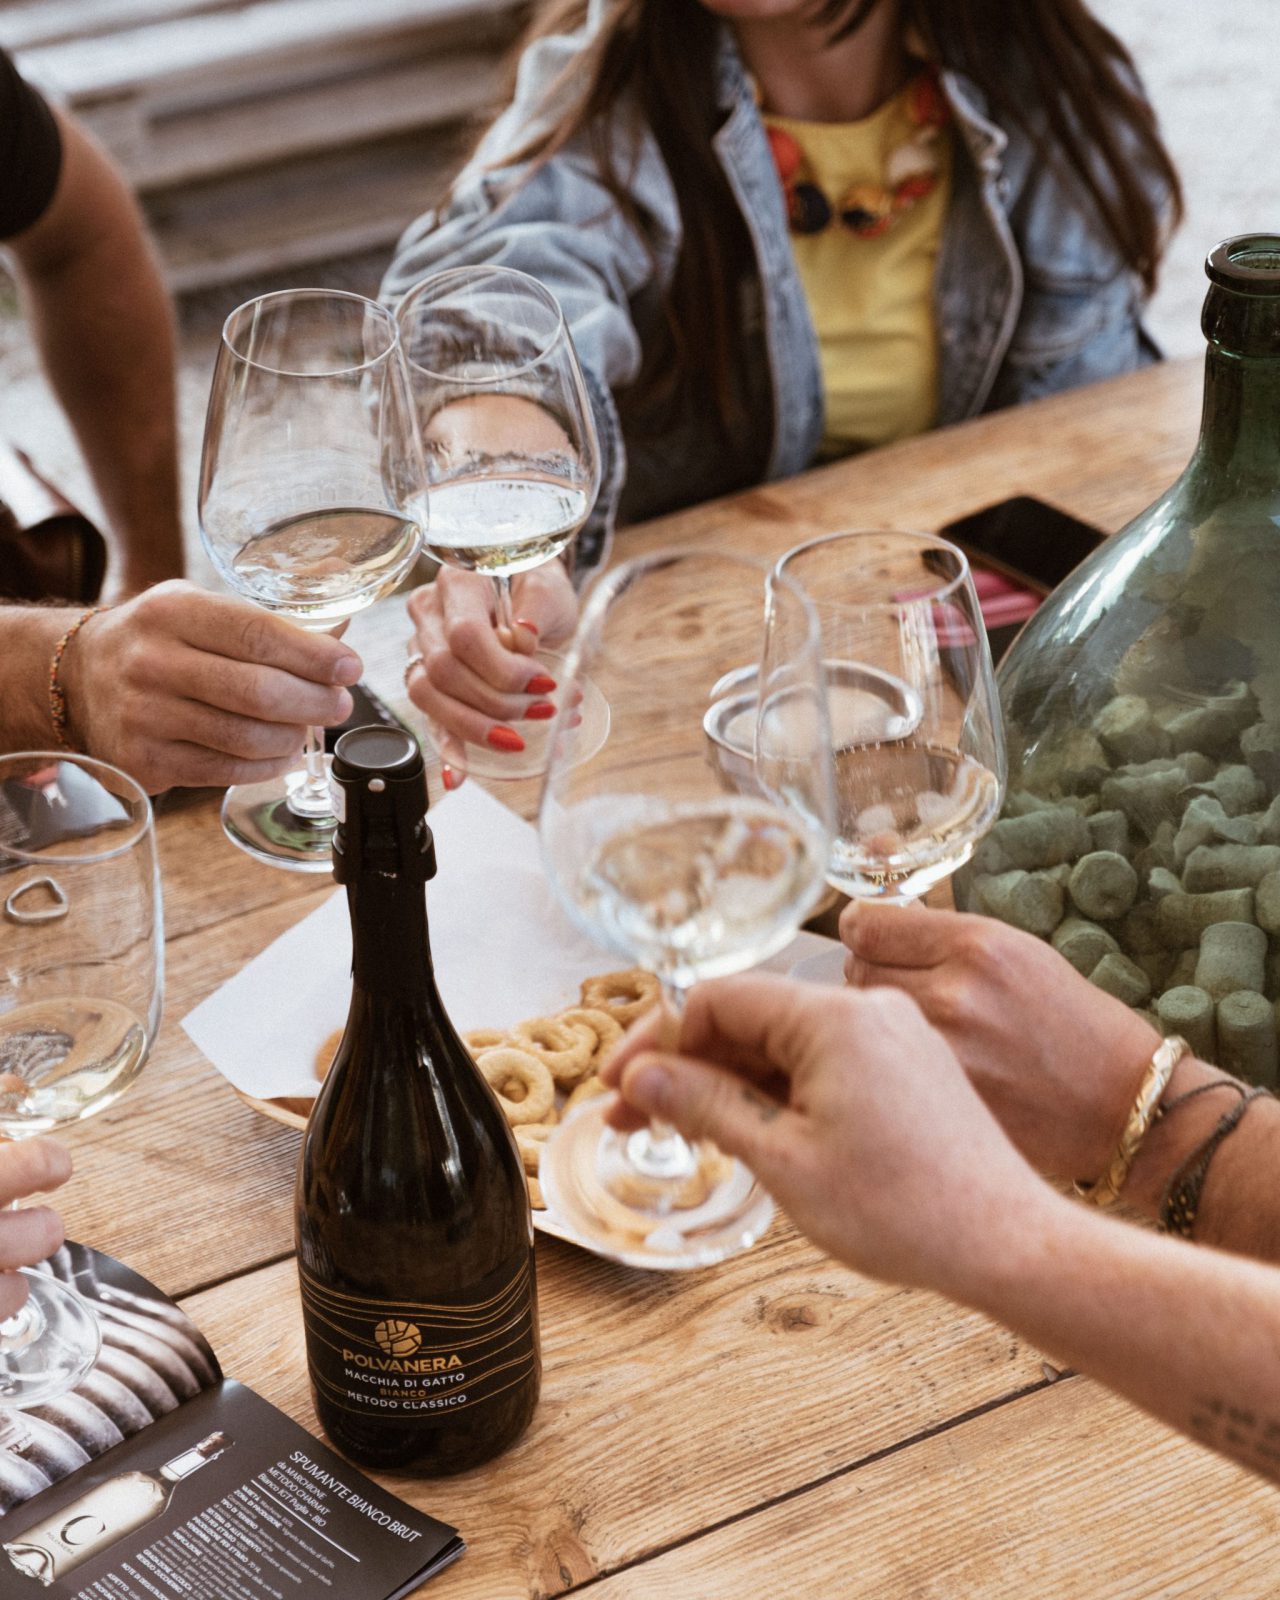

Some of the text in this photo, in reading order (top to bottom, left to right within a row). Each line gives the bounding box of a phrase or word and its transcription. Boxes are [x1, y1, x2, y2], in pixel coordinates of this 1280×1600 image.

[342, 1348, 463, 1373] POLVANERA
[345, 1368, 466, 1388] MACCHIA DI GATTO
[347, 1390, 468, 1410] METODO CLASSICO
[379, 1388, 426, 1398] BIANCO
[258, 1473, 280, 1491] Bianco
[277, 1489, 292, 1500] IGT
[267, 1467, 329, 1515] METODO CHARMAT
[285, 1468, 327, 1499] MARCHIONE
[288, 1451, 422, 1542] SPUMANTE BIANCO BRUT
